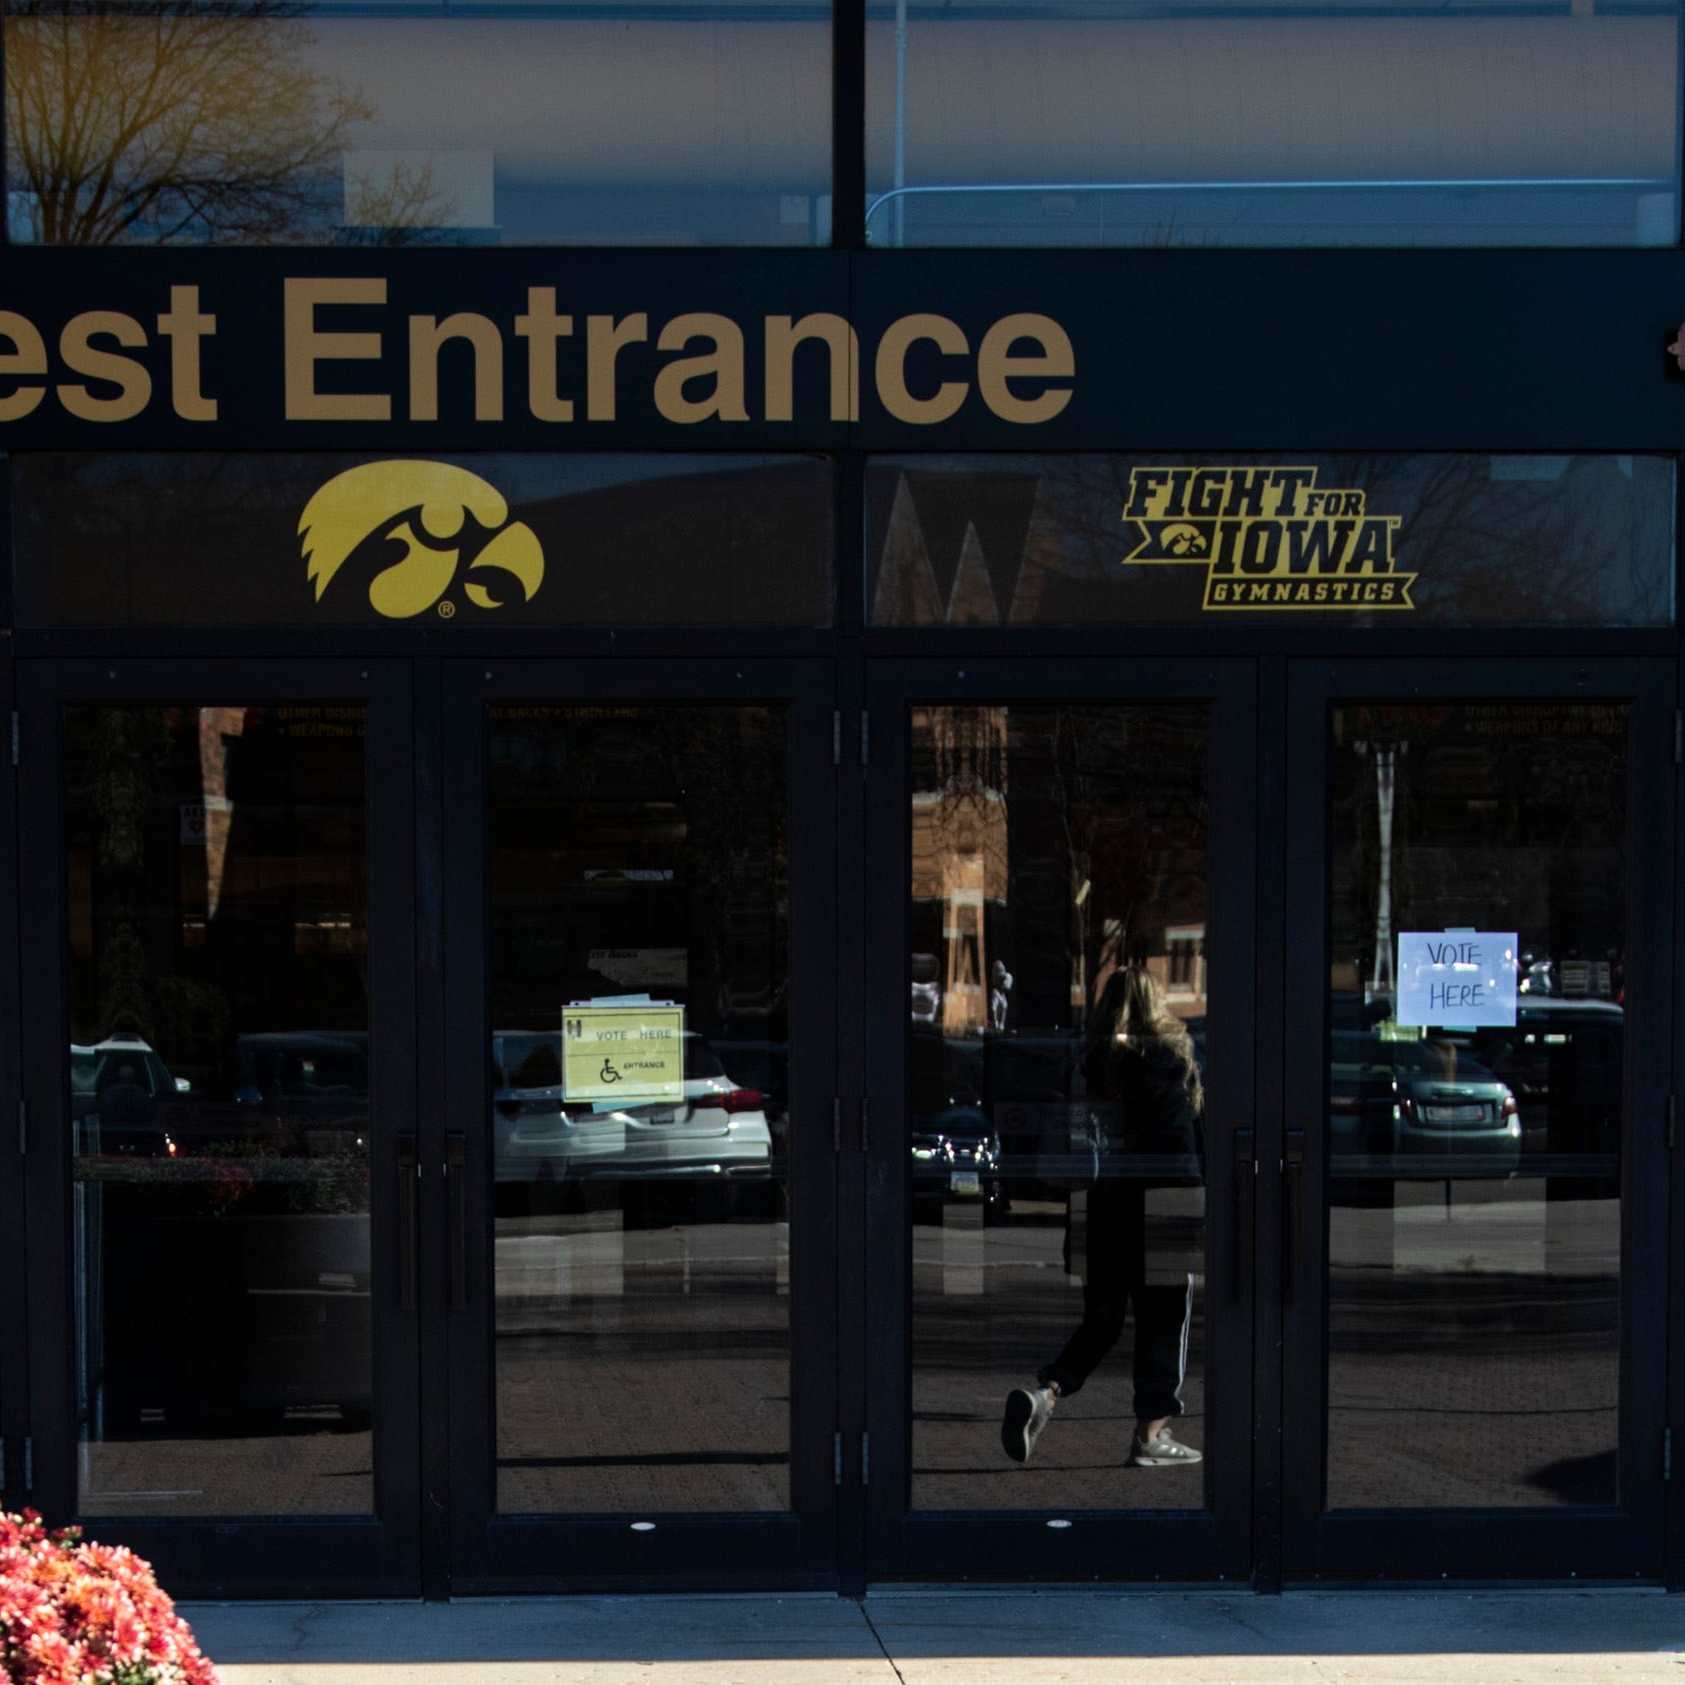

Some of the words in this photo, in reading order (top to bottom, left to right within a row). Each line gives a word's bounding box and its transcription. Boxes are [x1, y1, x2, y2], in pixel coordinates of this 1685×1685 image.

[285, 277, 1076, 425] Entrance
[1126, 469, 1313, 517] FIGHT
[1304, 493, 1362, 517] FOR
[1213, 520, 1390, 574] IOWA
[1214, 583, 1396, 603] GYMNASTICS
[1427, 942, 1483, 967] VOTE
[1430, 982, 1485, 1010] HERE
[596, 1031, 628, 1041] VOTE
[640, 1029, 672, 1040] HERE
[624, 1060, 665, 1070] ENTRANCE
